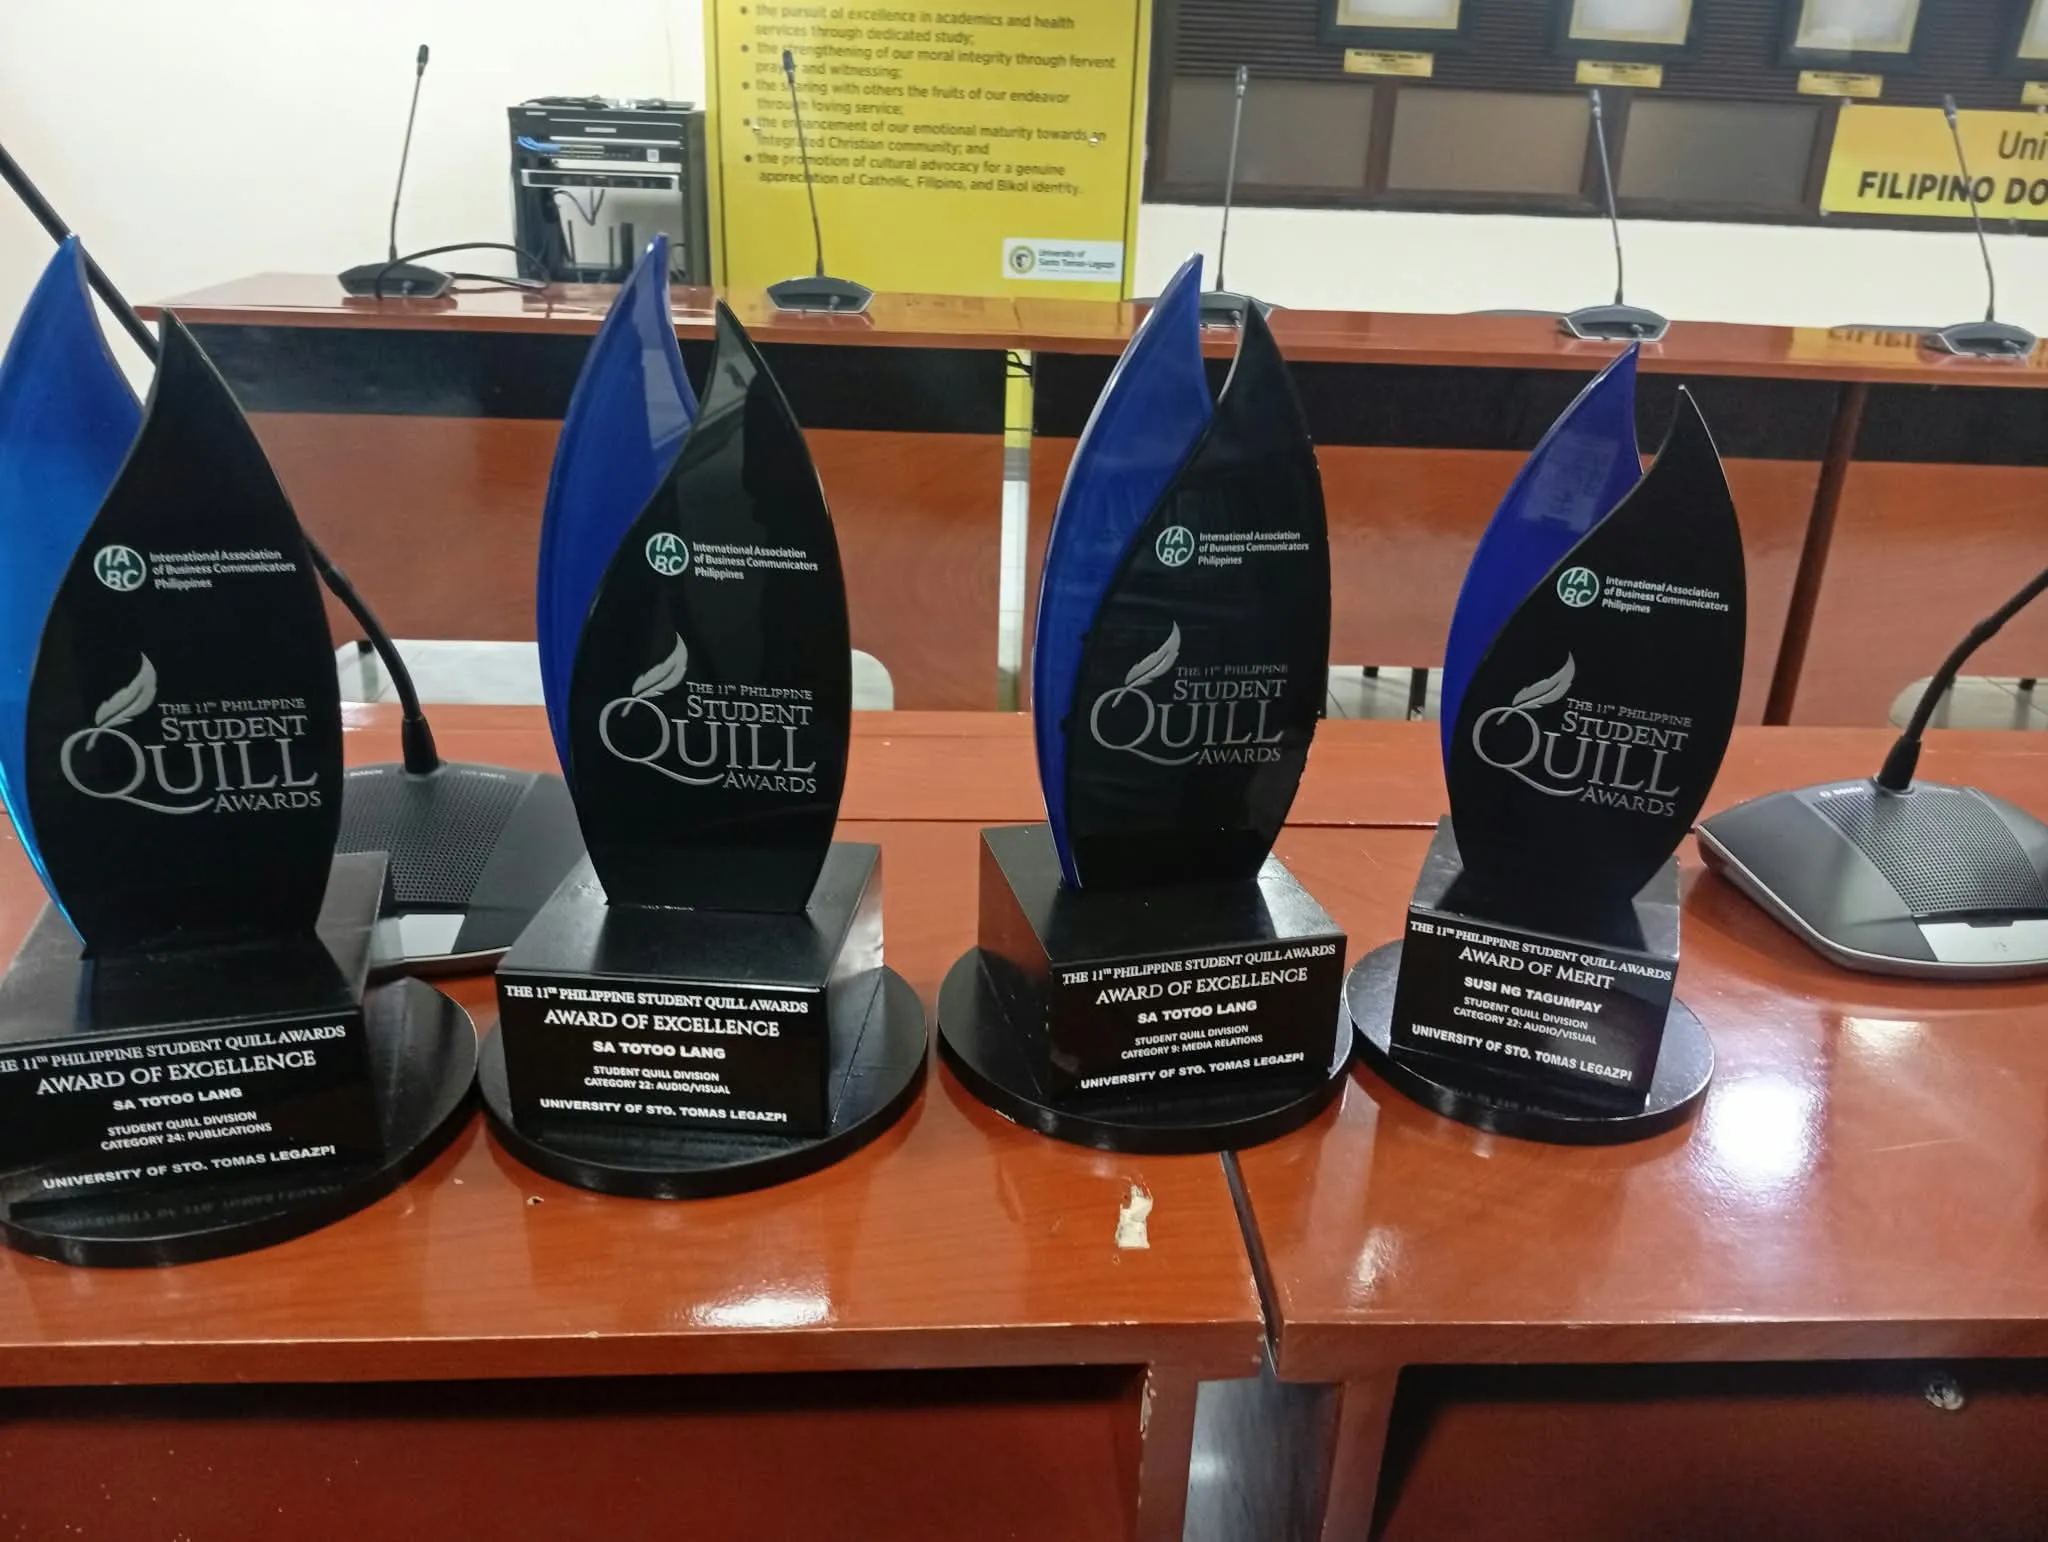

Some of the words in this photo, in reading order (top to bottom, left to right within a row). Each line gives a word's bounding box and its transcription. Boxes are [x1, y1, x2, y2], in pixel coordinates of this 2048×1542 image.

[848, 9, 915, 22] excellence
[919, 11, 932, 22] in
[935, 12, 1003, 26] academics
[1007, 15, 1031, 28] and
[1034, 15, 1075, 29] health
[876, 46, 889, 59] of
[892, 49, 914, 60] our
[917, 50, 954, 62] moral
[958, 51, 1012, 66] integrity
[1016, 53, 1066, 68] through
[1070, 55, 1116, 69] fervent
[831, 84, 861, 95] with
[863, 84, 904, 97] others
[908, 85, 928, 98] the
[932, 86, 965, 99] fruits
[968, 88, 982, 100] of
[985, 90, 1007, 101] our
[1010, 90, 1071, 103] endeavor
[871, 121, 884, 132] of
[888, 123, 909, 134] our
[913, 123, 976, 136] emotional
[980, 126, 1033, 141] maturity
[1036, 127, 1087, 141] towards
[829, 136, 883, 149] Christian
[965, 143, 990, 155] and
[758, 153, 778, 165] the
[853, 156, 866, 168] of
[870, 157, 917, 170] cultural
[920, 160, 979, 174] advocacy
[983, 161, 1001, 173] for
[1016, 164, 1065, 176] genuine
[843, 173, 856, 185] of
[970, 179, 994, 191] and
[997, 179, 1029, 192] Bikol
[1857, 171, 1995, 204] FILIPINO
[2004, 177, 2048, 206] DO
[693, 542, 753, 556] International
[754, 546, 807, 559] Association
[694, 554, 705, 564] of
[705, 554, 746, 567] Business
[746, 558, 818, 572] Communicators
[695, 567, 744, 580] Philippines
[1604, 587, 1615, 596] of
[1615, 588, 1655, 602] Business
[1655, 593, 1729, 612] Communicators
[1606, 576, 1666, 592] International
[1666, 583, 1720, 599] Association
[1602, 599, 1650, 614] Philippines
[686, 681, 715, 694] THE
[740, 685, 813, 700] PHILIPPINE
[1173, 679, 1287, 701] STUDENT
[158, 702, 192, 715] THE
[221, 698, 306, 713] PHILIPPINE
[687, 695, 813, 725] STUDENT
[1567, 698, 1593, 712] THE
[1617, 706, 1693, 727] PHILIPPINE
[161, 715, 308, 742] STUDENT
[1090, 687, 1284, 765] QUILL
[1561, 711, 1689, 751] STUDENT
[599, 697, 816, 785] QUILL
[1472, 706, 1680, 797] QUILL
[1198, 747, 1281, 765] AWARDS
[60, 727, 319, 814] QUILL
[722, 771, 817, 794] AWARDS
[213, 791, 322, 813] AWARDS
[1579, 785, 1675, 817] AWARDS
[1410, 920, 1433, 934] THE
[1455, 930, 1520, 951] PHILIPPINE
[1522, 943, 1579, 962] STUDENT
[1580, 954, 1617, 971] QUILL
[1619, 962, 1672, 981] AWARDS
[1062, 971, 1088, 985] THE
[1113, 960, 1182, 979] PHILIPPINE
[1185, 954, 1243, 971] STUDENT
[1245, 949, 1283, 965] QUILL
[1284, 944, 1336, 960] AWARDS
[1458, 946, 1524, 971] AWARD
[1528, 961, 1553, 977] OF
[1555, 965, 1615, 989] MERIT
[1095, 984, 1163, 1005] AWARD
[1167, 980, 1192, 996] OF
[1196, 967, 1308, 993] EXCELLENCE
[1464, 976, 1498, 992] SUSI
[1501, 983, 1521, 998] NG
[1525, 989, 1603, 1014] TAGUMPAY
[504, 985, 533, 998] THE
[559, 988, 634, 1004] PHILIPPINE
[637, 992, 703, 1008] STUDENT
[704, 996, 748, 1011] QUILL
[750, 999, 808, 1013] AWARDS
[544, 1009, 617, 1028] AWARD
[621, 1013, 649, 1030] OF
[653, 1015, 780, 1037] EXCELLENCE
[1138, 1011, 1158, 1024] SA
[1161, 1005, 1213, 1021] TOTOO
[1217, 1000, 1257, 1015] LANG
[1453, 1006, 1505, 1024] CATEGORY
[1464, 996, 1510, 1013] STUDENT
[1511, 1006, 1540, 1020] QUILL
[1543, 1012, 1589, 1030] DIVISION
[51, 1046, 144, 1068] PHILIPPINE
[146, 1038, 223, 1058] STUDENT
[225, 1032, 277, 1051] QUILL
[278, 1025, 346, 1044] AWARDS
[1121, 1046, 1169, 1059] CATEGORY
[1182, 1040, 1213, 1052] MEDIA
[1214, 1034, 1263, 1048] RELATIONS
[1134, 1033, 1178, 1046] STUDENT
[1179, 1029, 1206, 1041] QUILL
[1208, 1024, 1249, 1037] DIVISION
[592, 1040, 616, 1053] SA
[618, 1042, 676, 1057] TOTOO
[680, 1046, 726, 1060] LANG
[1411, 1023, 1483, 1048] UNIVERSITY
[1485, 1040, 1503, 1053] OF
[1504, 1044, 1532, 1060] STO.
[1535, 1050, 1577, 1069] TOMAS
[1579, 1060, 1633, 1082] LEGAZPI
[36, 1070, 125, 1096] AWARD
[130, 1066, 162, 1085] OF
[169, 1050, 317, 1082] EXCELLENCE
[584, 1077, 637, 1088] CATEGORY
[593, 1065, 640, 1077] STUDENT
[641, 1069, 672, 1079] QUILL
[673, 1070, 719, 1081] DIVISION
[1080, 1070, 1156, 1089] UNIVERSITY
[1158, 1068, 1176, 1079] OF
[1179, 1064, 1206, 1076] STO.
[1208, 1058, 1251, 1072] TOMAS
[1253, 1052, 1304, 1067] LEGAZPI
[113, 1099, 136, 1111] SA
[138, 1093, 194, 1109] TOTOO
[198, 1087, 243, 1102] LANG
[539, 1098, 621, 1112] UNIVERSITY
[624, 1104, 643, 1114] OF
[646, 1105, 676, 1116] STO.
[679, 1106, 727, 1119] TOMAS
[729, 1109, 788, 1122] LEGAZPI
[100, 1134, 164, 1151] CATEGORY
[187, 1122, 272, 1141] PUBLICATIONS
[107, 1121, 164, 1137] STUDENT
[166, 1117, 202, 1130] QUILL
[203, 1111, 257, 1126] DIVISION
[42, 1168, 142, 1190] UNIVERSITY
[147, 1164, 168, 1177] OF
[171, 1162, 208, 1174] STO.
[211, 1153, 266, 1169] TOMAS
[270, 1145, 336, 1162] LEGAZPI
